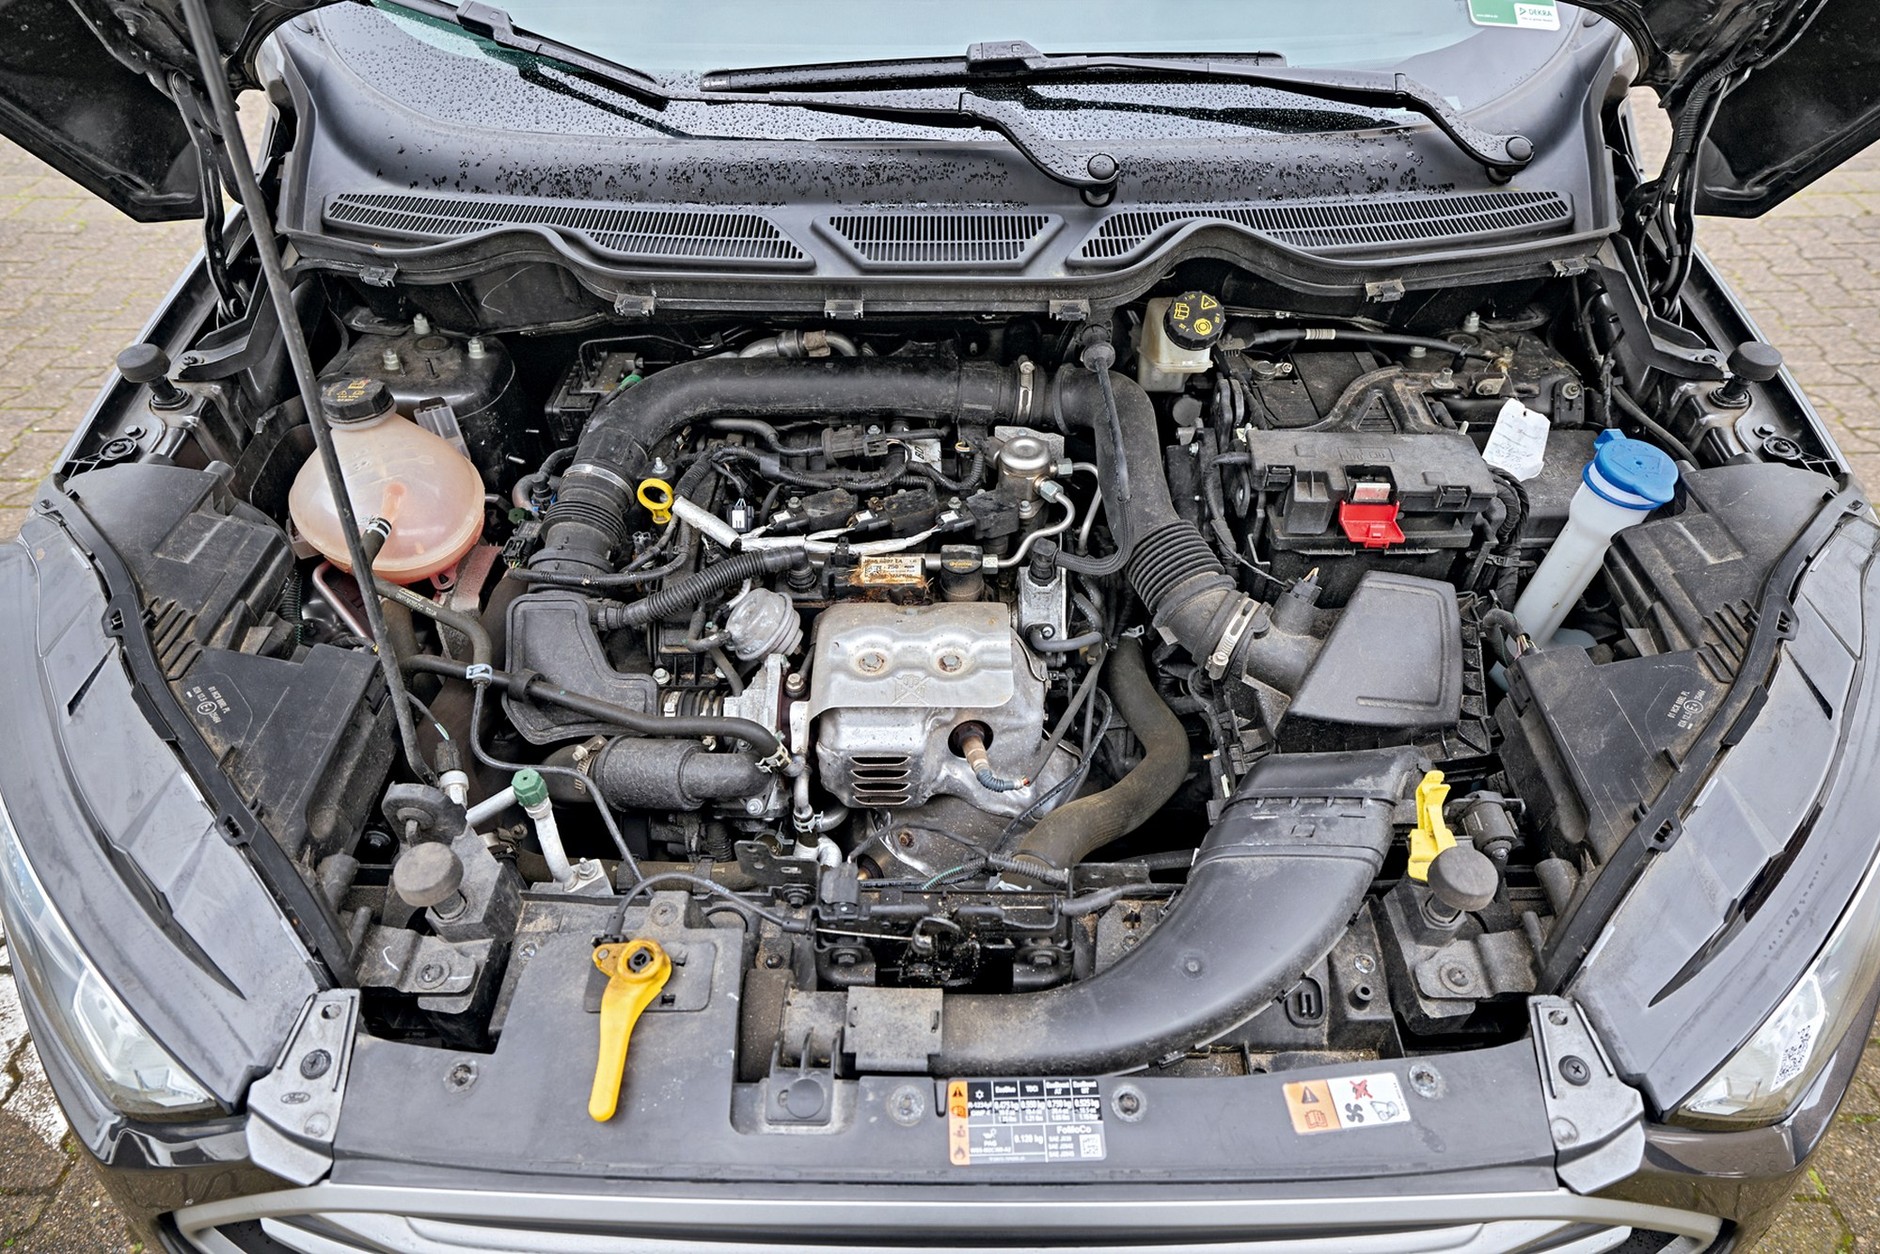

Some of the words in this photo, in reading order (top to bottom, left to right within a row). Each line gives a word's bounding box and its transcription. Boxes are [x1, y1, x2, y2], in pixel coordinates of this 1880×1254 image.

[1528, 8, 1552, 16] DEKRA
[1056, 1125, 1092, 1134] FoMoCo
[1014, 1135, 1033, 1143] 0.120
[1034, 1135, 1043, 1144] kg
